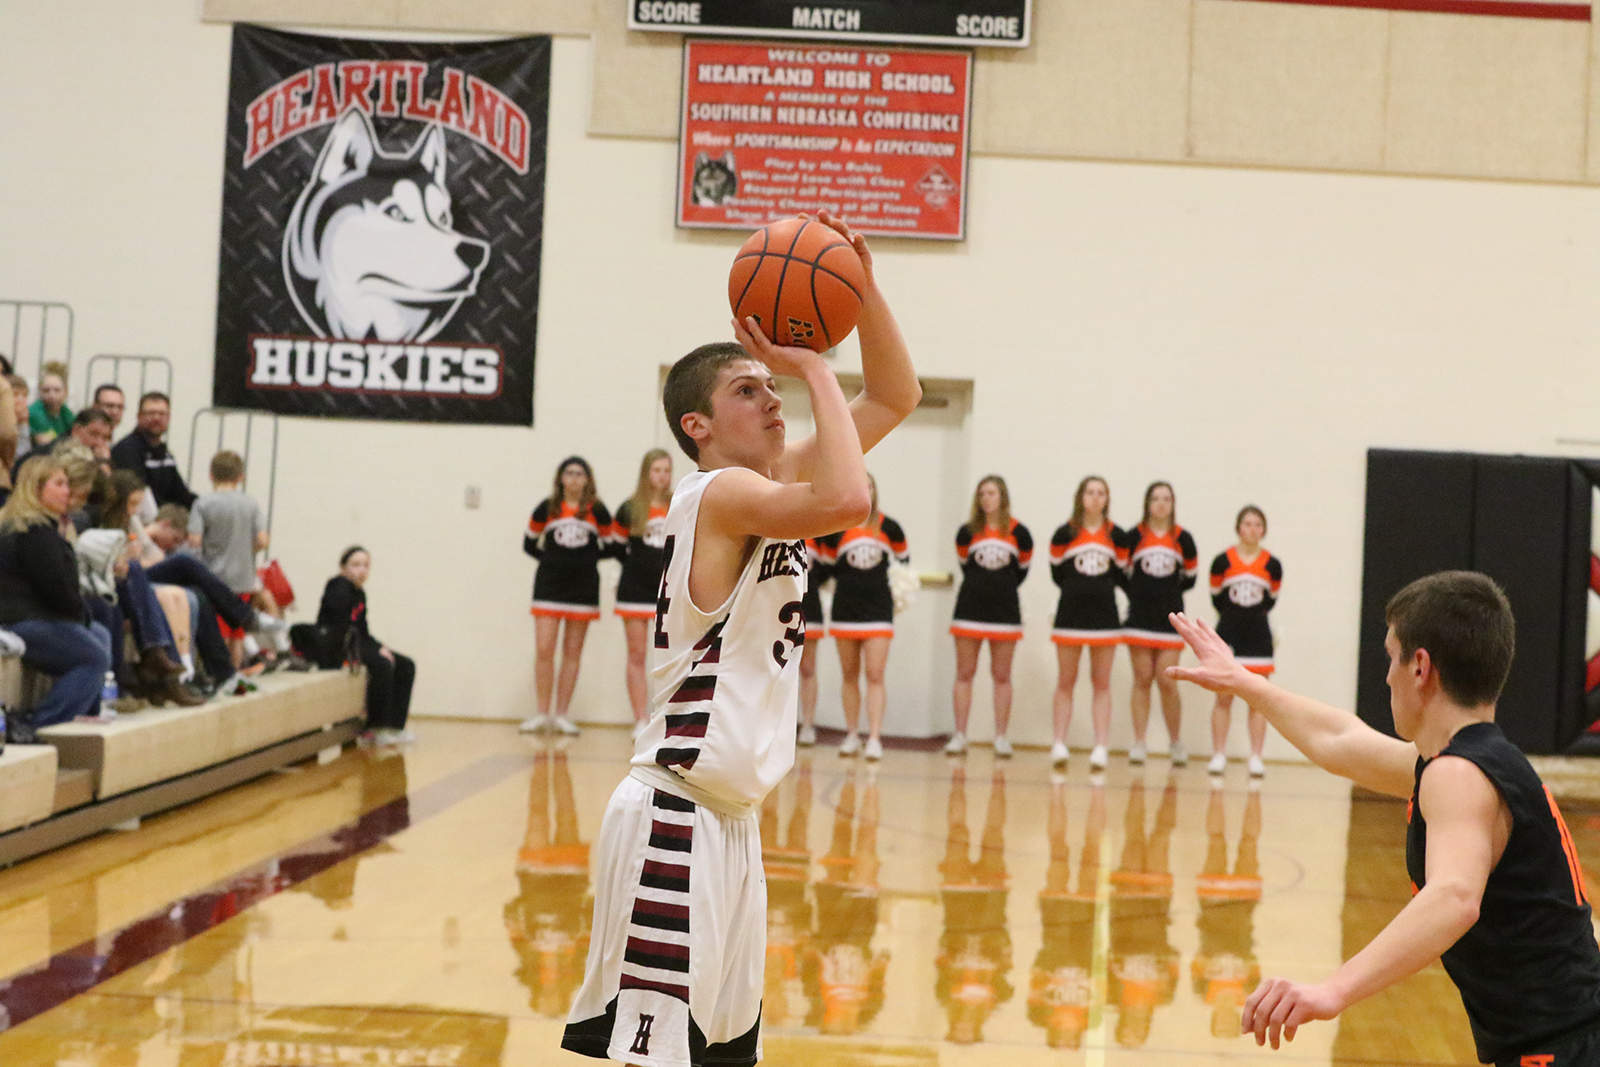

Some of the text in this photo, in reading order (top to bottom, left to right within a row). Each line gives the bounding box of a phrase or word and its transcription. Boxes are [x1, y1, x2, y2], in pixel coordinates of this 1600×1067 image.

[638, 1, 700, 24] SCORE
[792, 7, 861, 30] MATCH
[956, 15, 1019, 38] SCORE
[767, 49, 891, 67] WELCOME TO
[698, 63, 955, 95] HEARTLAND HIGH SCHOOL
[243, 60, 531, 175] HEARTLAND
[690, 102, 960, 132] SOUTHERN NEBRASKA CONFERENCE
[734, 132, 840, 151] SPORTSMANSHIP
[874, 139, 957, 157] EXPECTATION
[250, 337, 501, 395] HUSKIES
